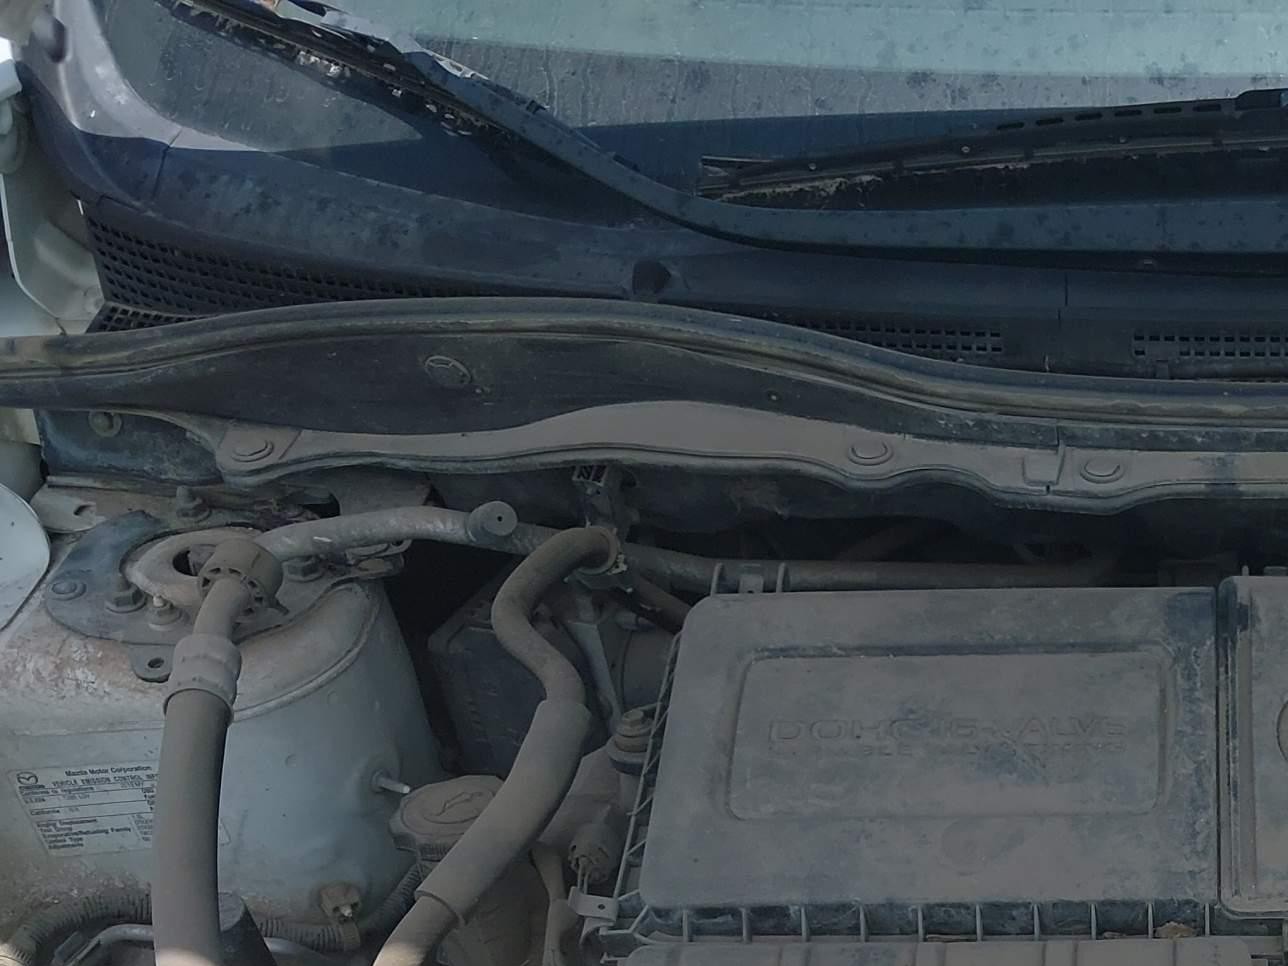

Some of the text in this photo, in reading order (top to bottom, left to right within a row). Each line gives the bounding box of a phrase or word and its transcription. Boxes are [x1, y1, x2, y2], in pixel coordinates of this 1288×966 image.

[768, 718, 932, 742] DOHC
[65, 765, 153, 777] Mazda Motor Corporation
[52, 779, 78, 787] VEHICLE
[114, 774, 143, 782] CONTROL
